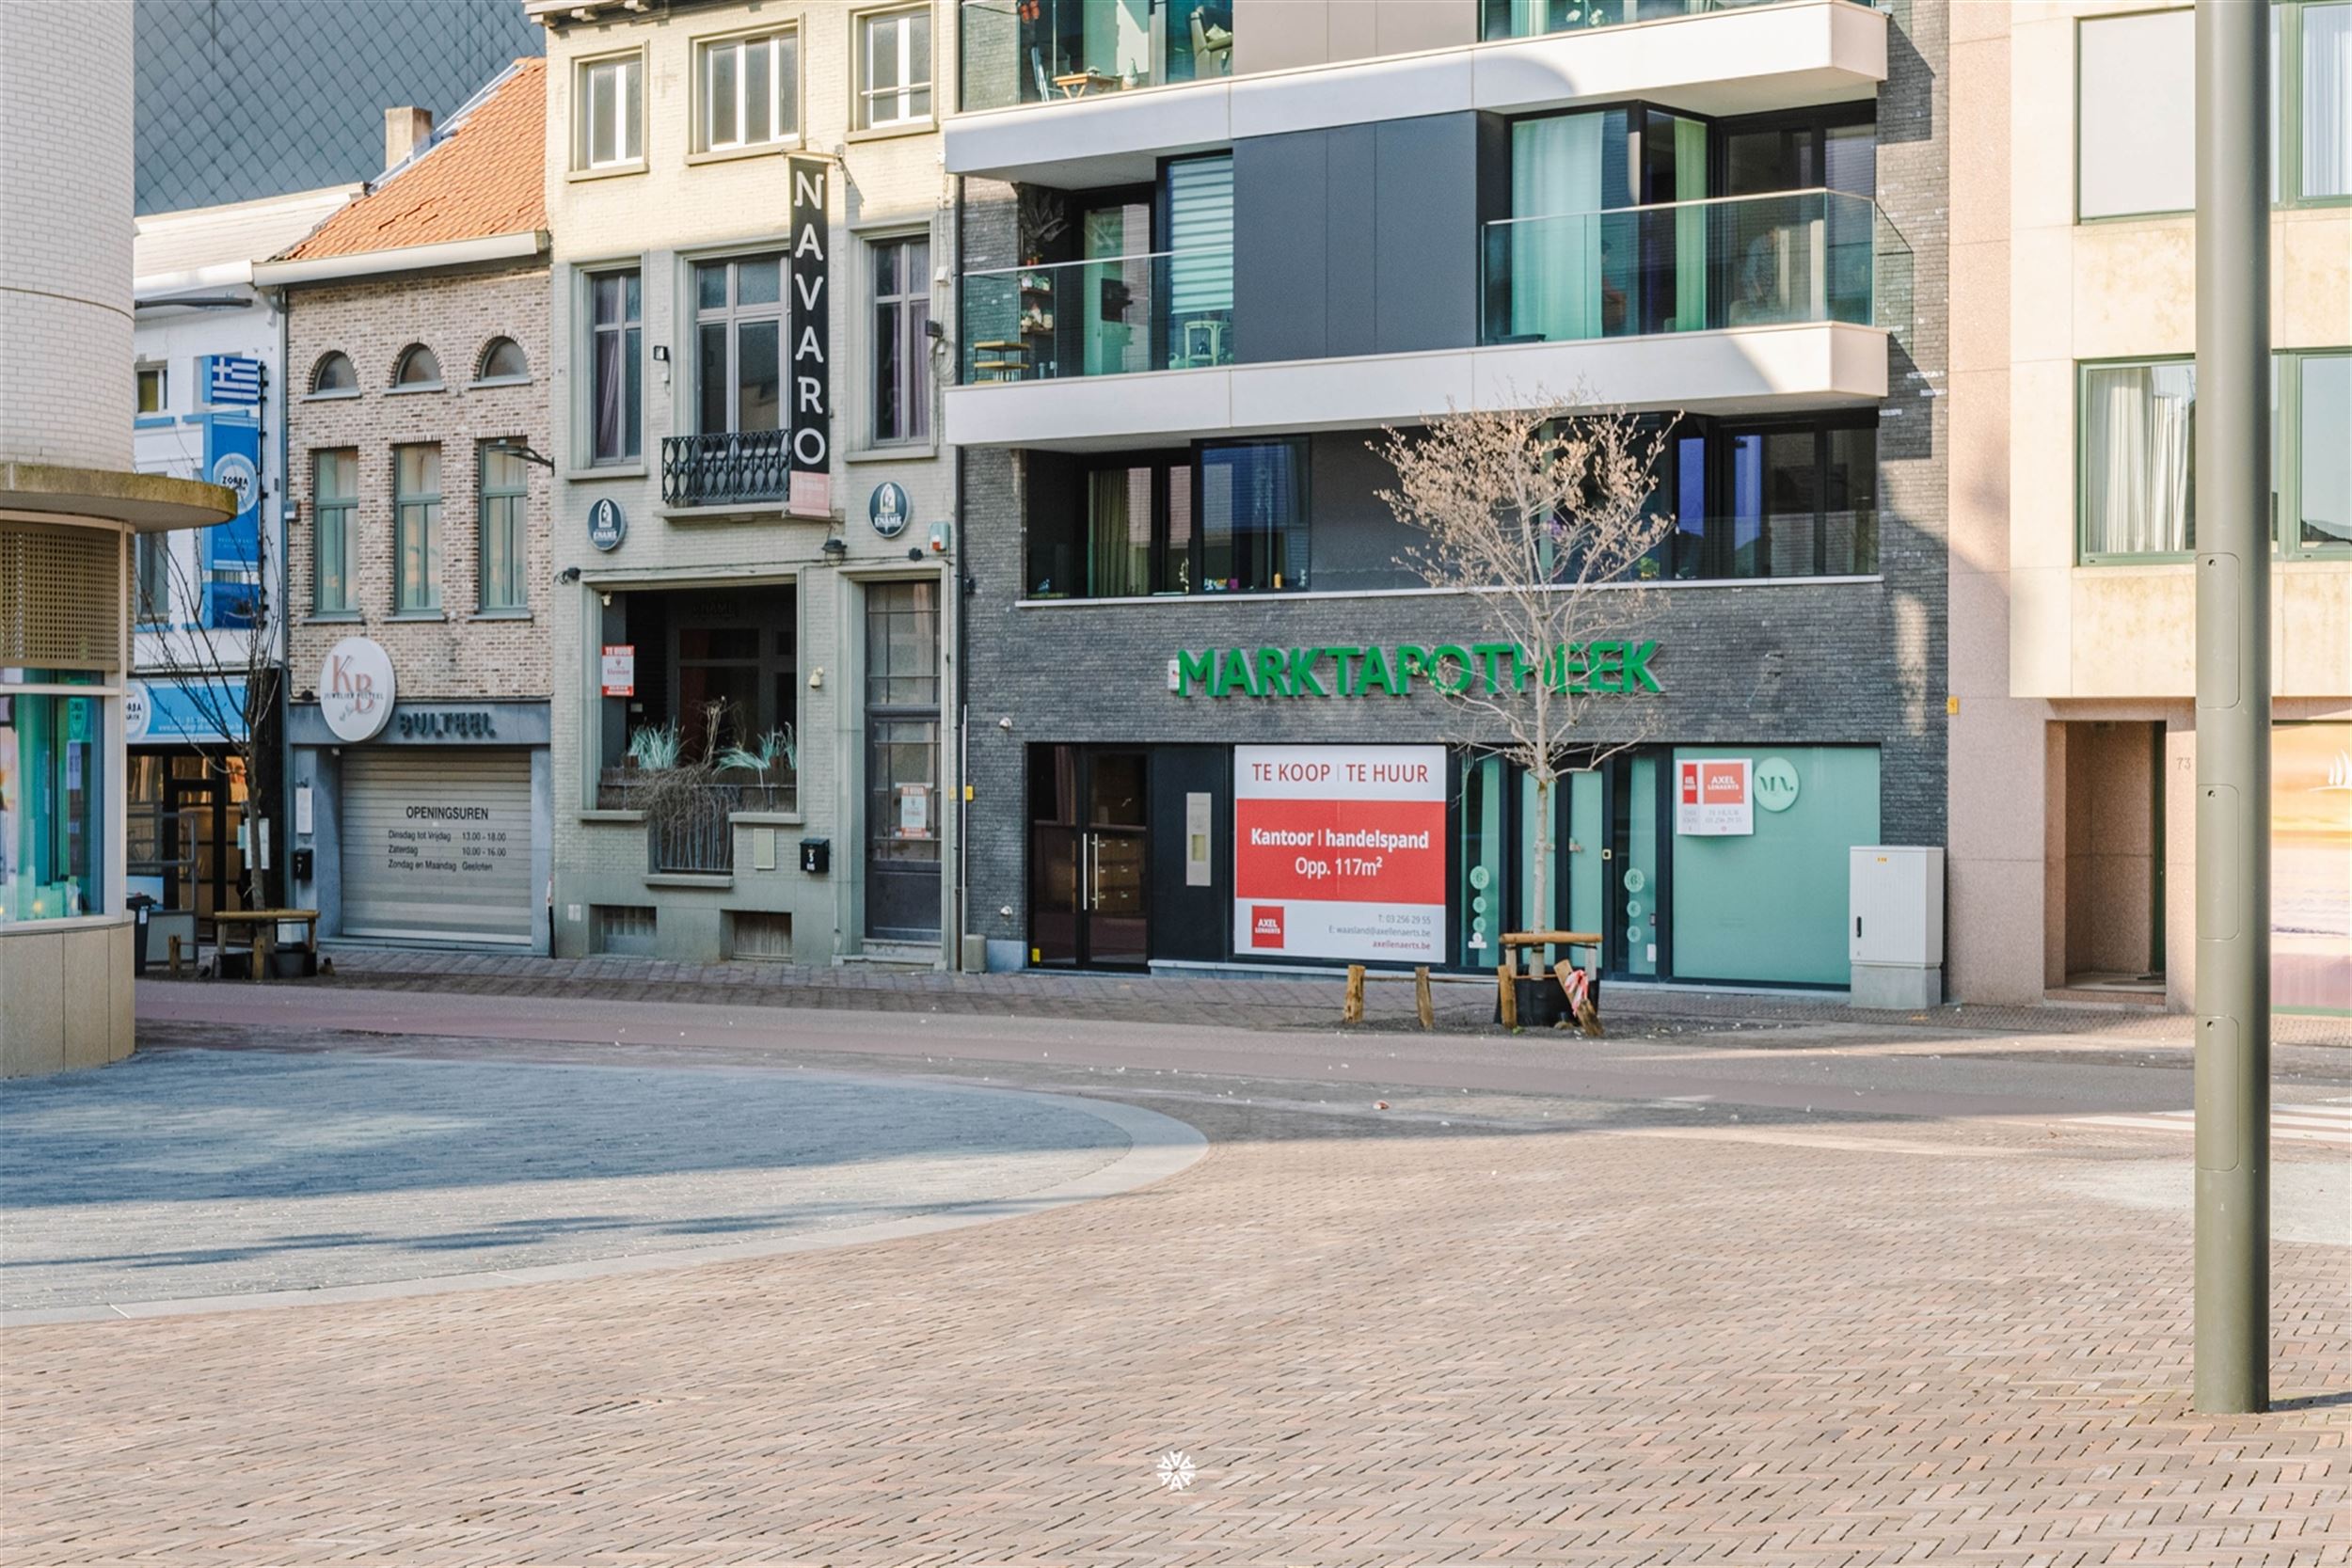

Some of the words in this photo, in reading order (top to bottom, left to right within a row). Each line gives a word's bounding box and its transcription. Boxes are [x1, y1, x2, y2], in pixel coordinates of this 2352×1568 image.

[794, 170, 825, 465] NAVARO
[1178, 640, 1664, 697] MARKTAPOTHEEK
[399, 712, 497, 738] BULTEEL
[2177, 757, 2191, 769] 73
[1252, 764, 1272, 782] TE
[1279, 764, 1330, 782] KOOP
[1346, 764, 1366, 783] TE
[1373, 764, 1428, 783] HUUR
[405, 806, 489, 820] OPENINGSUREN
[388, 830, 416, 842] Dinsdag
[428, 831, 452, 843] Vrijdag
[462, 832, 481, 841] 13.00
[487, 832, 506, 842] 18.00
[1251, 829, 1314, 846] Kantoor
[1326, 829, 1429, 852] handelspand
[388, 845, 419, 857] Zaterdag
[462, 847, 481, 856] 10.00
[487, 847, 506, 857] 16.00
[388, 859, 414, 871] Zondag
[425, 861, 457, 873] Maandag
[461, 861, 493, 872] Gesloten
[1295, 857, 1331, 879] Opp.
[1257, 918, 1278, 927] AXEL
[1386, 915, 1395, 924] 03
[1396, 915, 1410, 924] 256
[1411, 915, 1421, 924] 29
[1422, 916, 1431, 925] 55
[1337, 927, 1431, 938] waasland@axellenaerts.be
[1373, 941, 1431, 950] axellenaerts.be
